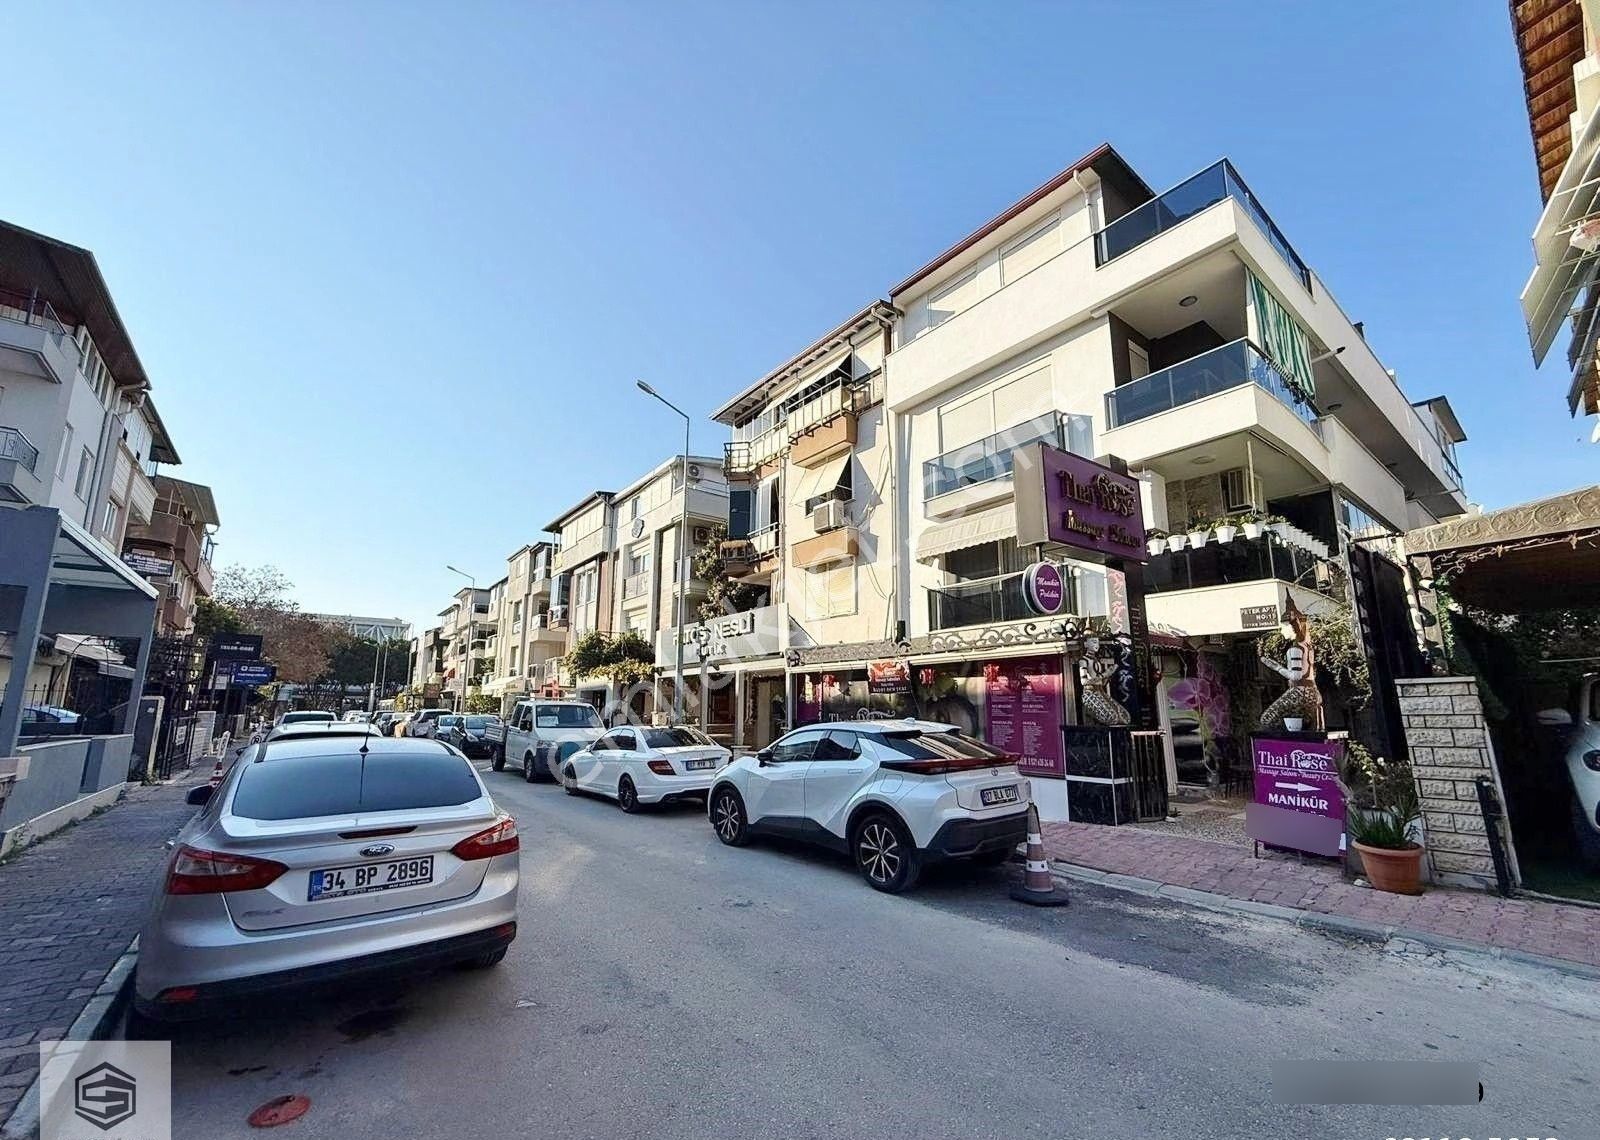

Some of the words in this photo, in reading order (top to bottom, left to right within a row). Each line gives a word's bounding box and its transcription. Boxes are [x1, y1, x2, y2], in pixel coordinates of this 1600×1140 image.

[1258, 751, 1288, 767] Thai
[1290, 750, 1328, 771] Rose
[1268, 793, 1329, 810] MANİKÜR
[323, 871, 346, 892] 34
[355, 866, 378, 887] BP
[387, 859, 430, 882] 2896
